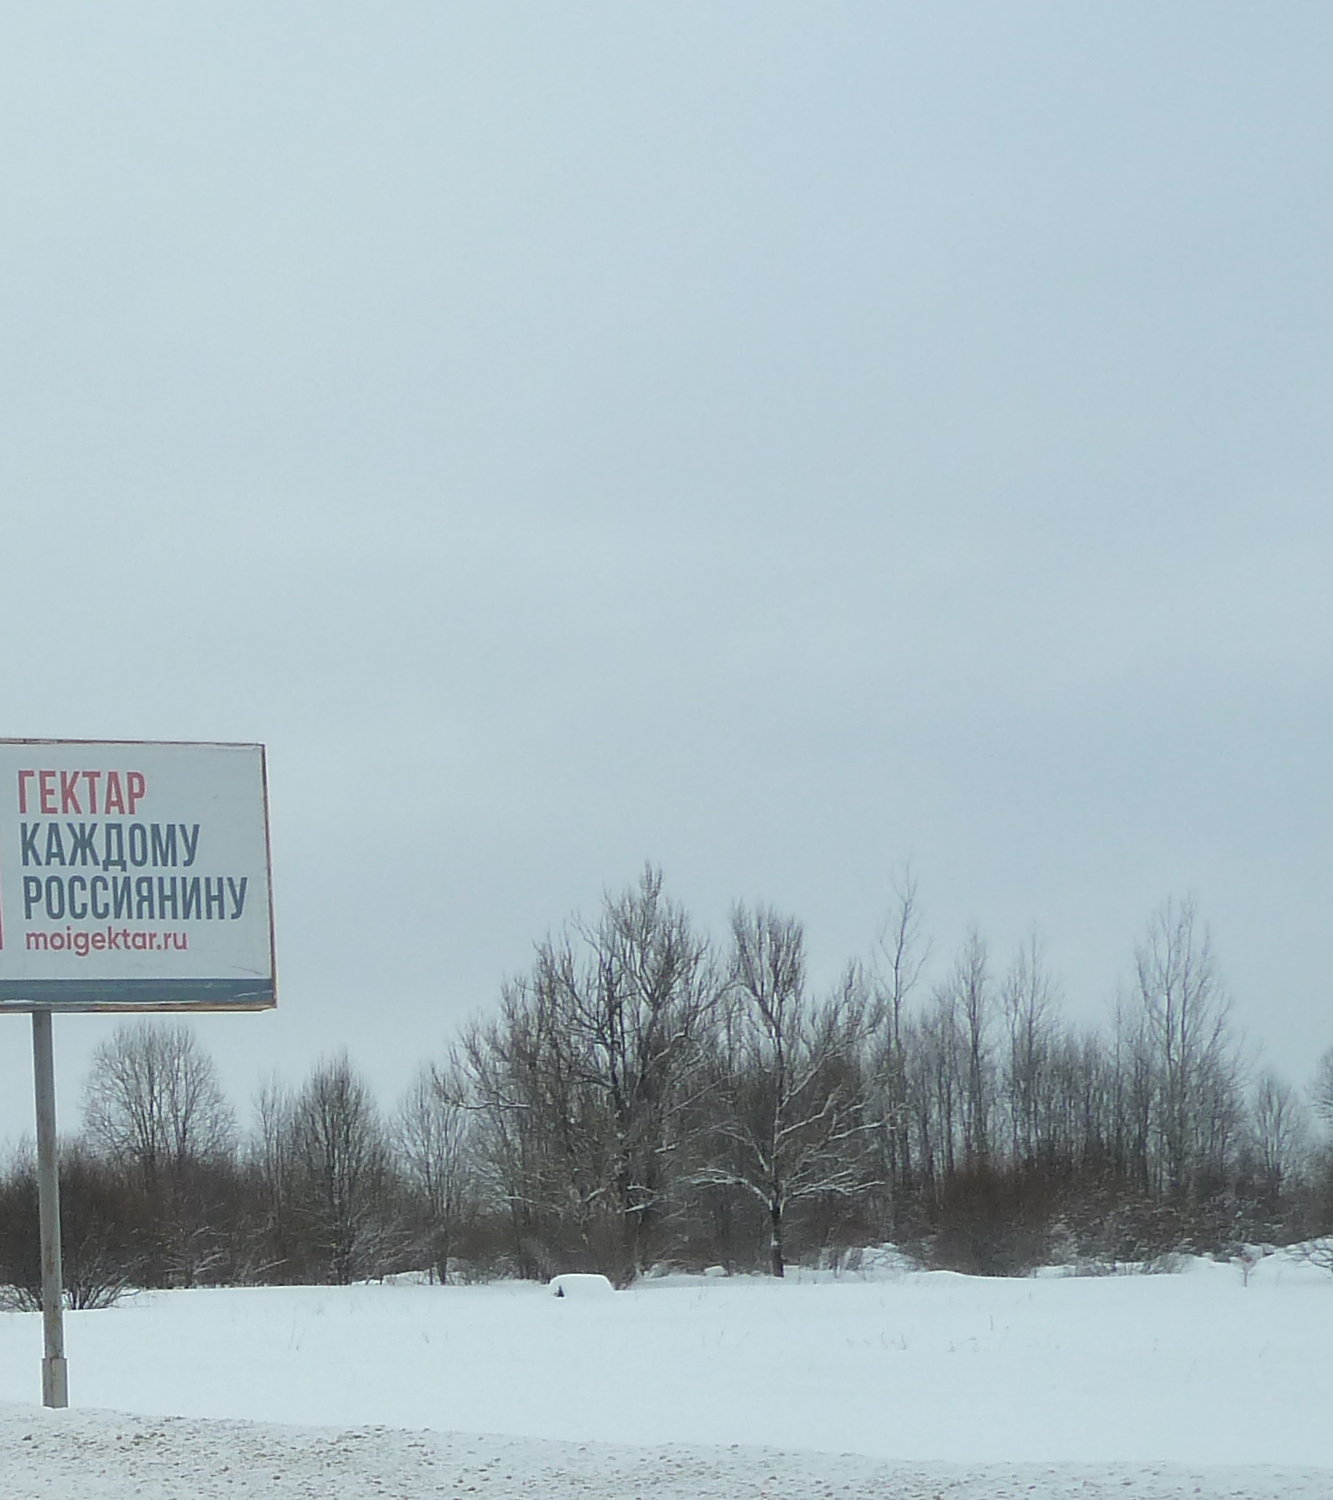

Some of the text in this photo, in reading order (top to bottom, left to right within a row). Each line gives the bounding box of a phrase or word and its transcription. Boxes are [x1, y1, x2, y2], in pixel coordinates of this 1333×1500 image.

[18, 770, 145, 815] ГЕКТАР
[20, 822, 200, 872] КАЖДОМУ
[23, 875, 248, 920] РОССИЯНИНУ
[25, 925, 188, 957] moigektar.ru
